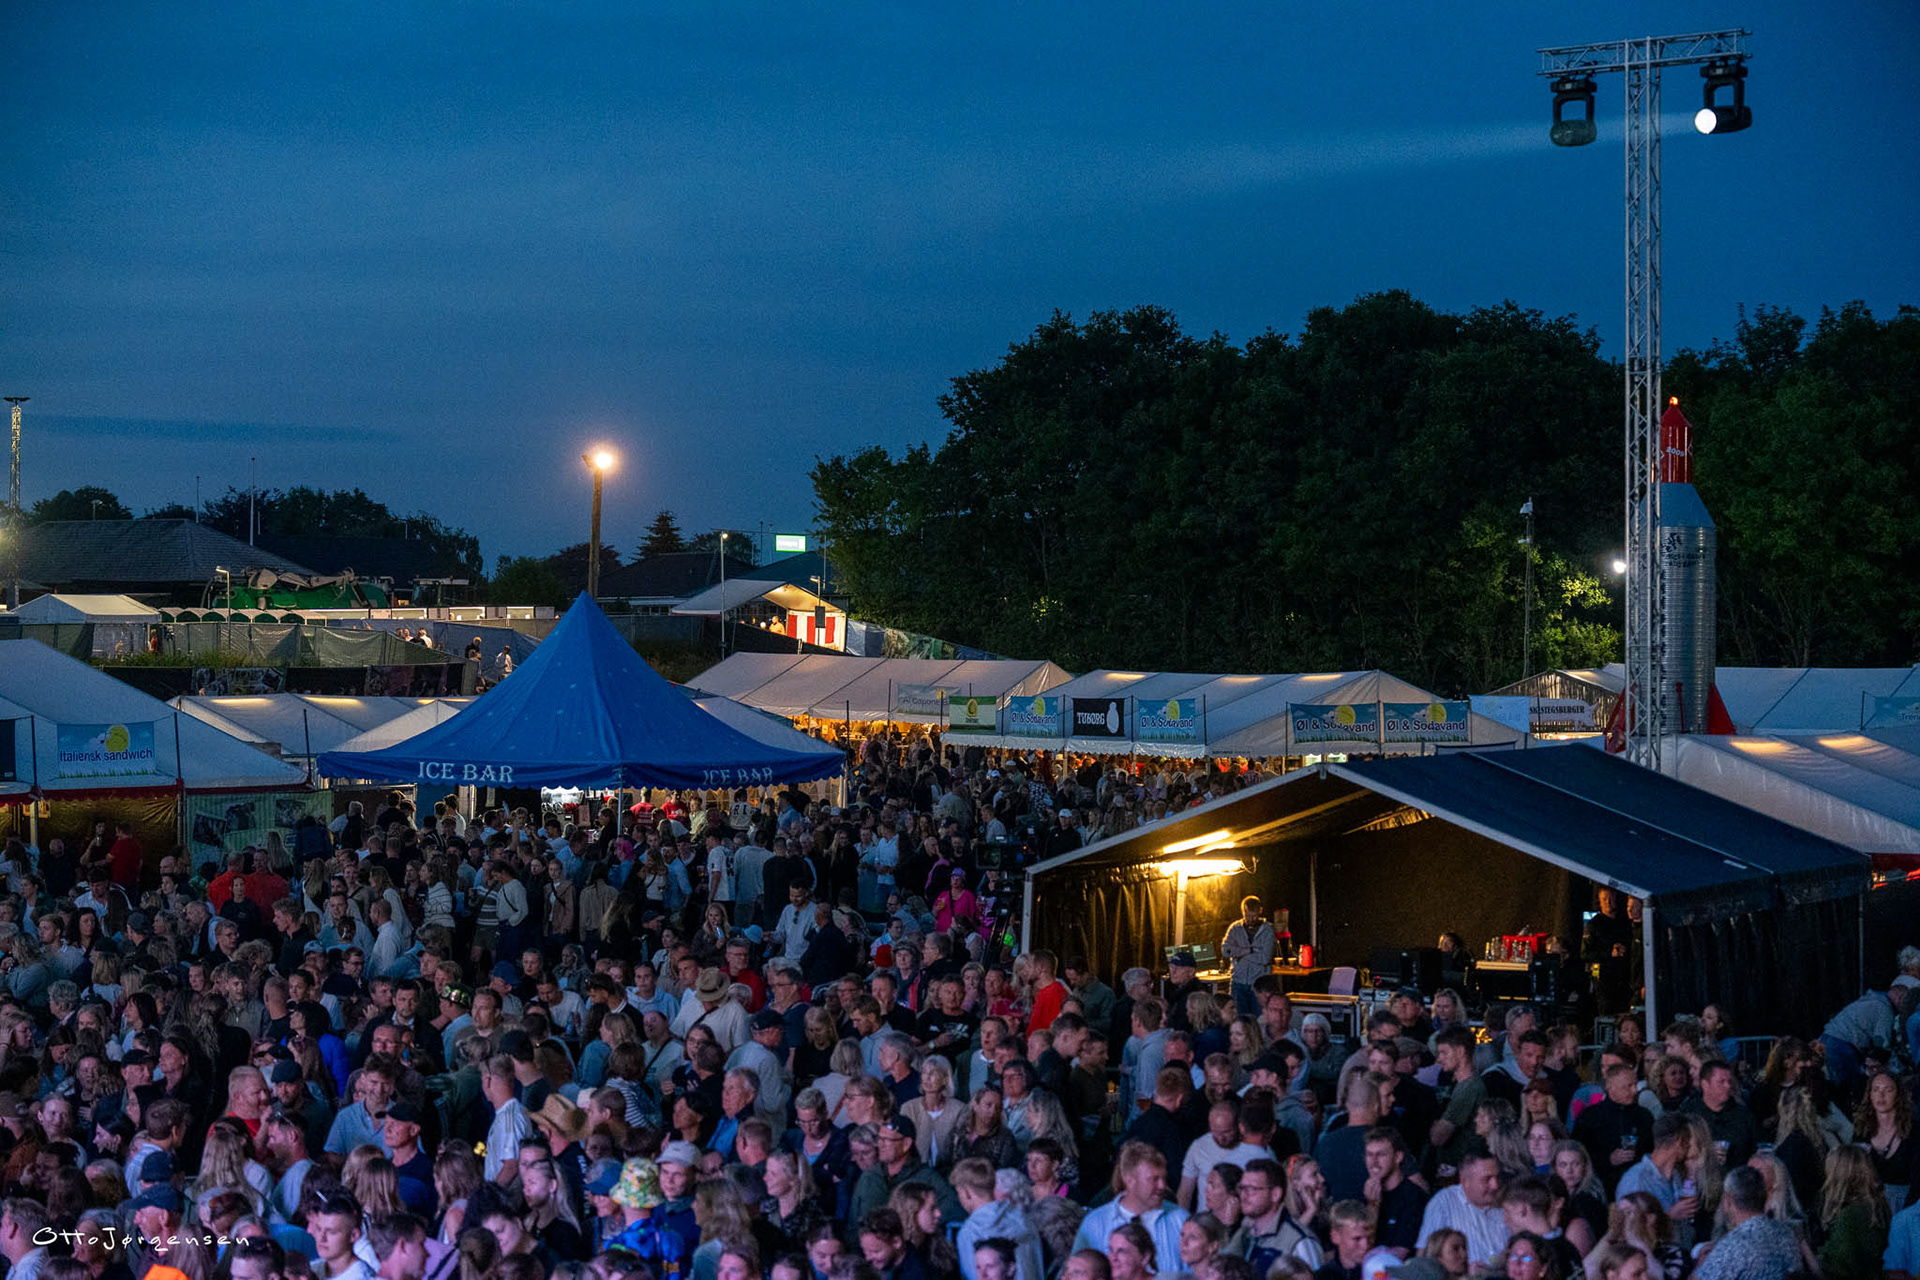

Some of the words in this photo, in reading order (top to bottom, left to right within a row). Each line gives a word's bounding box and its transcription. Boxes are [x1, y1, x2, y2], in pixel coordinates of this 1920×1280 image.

[1011, 712, 1019, 723] Øl
[1026, 713, 1058, 724] Sodavand
[1077, 712, 1105, 725] TUBORG
[1141, 716, 1149, 728] Øl
[1150, 717, 1156, 728] &
[1158, 716, 1194, 728] Sodavand
[1296, 719, 1308, 731] Øl
[1311, 719, 1320, 730] &
[1387, 719, 1398, 731] Øl
[1402, 719, 1410, 731] &
[1413, 719, 1465, 731] Sodavand
[60, 750, 101, 762] Italiensk
[103, 747, 153, 761] sandwich
[418, 761, 455, 779] ICE
[462, 763, 513, 783] BAR
[702, 769, 730, 785] ICE
[737, 766, 773, 784] BAR
